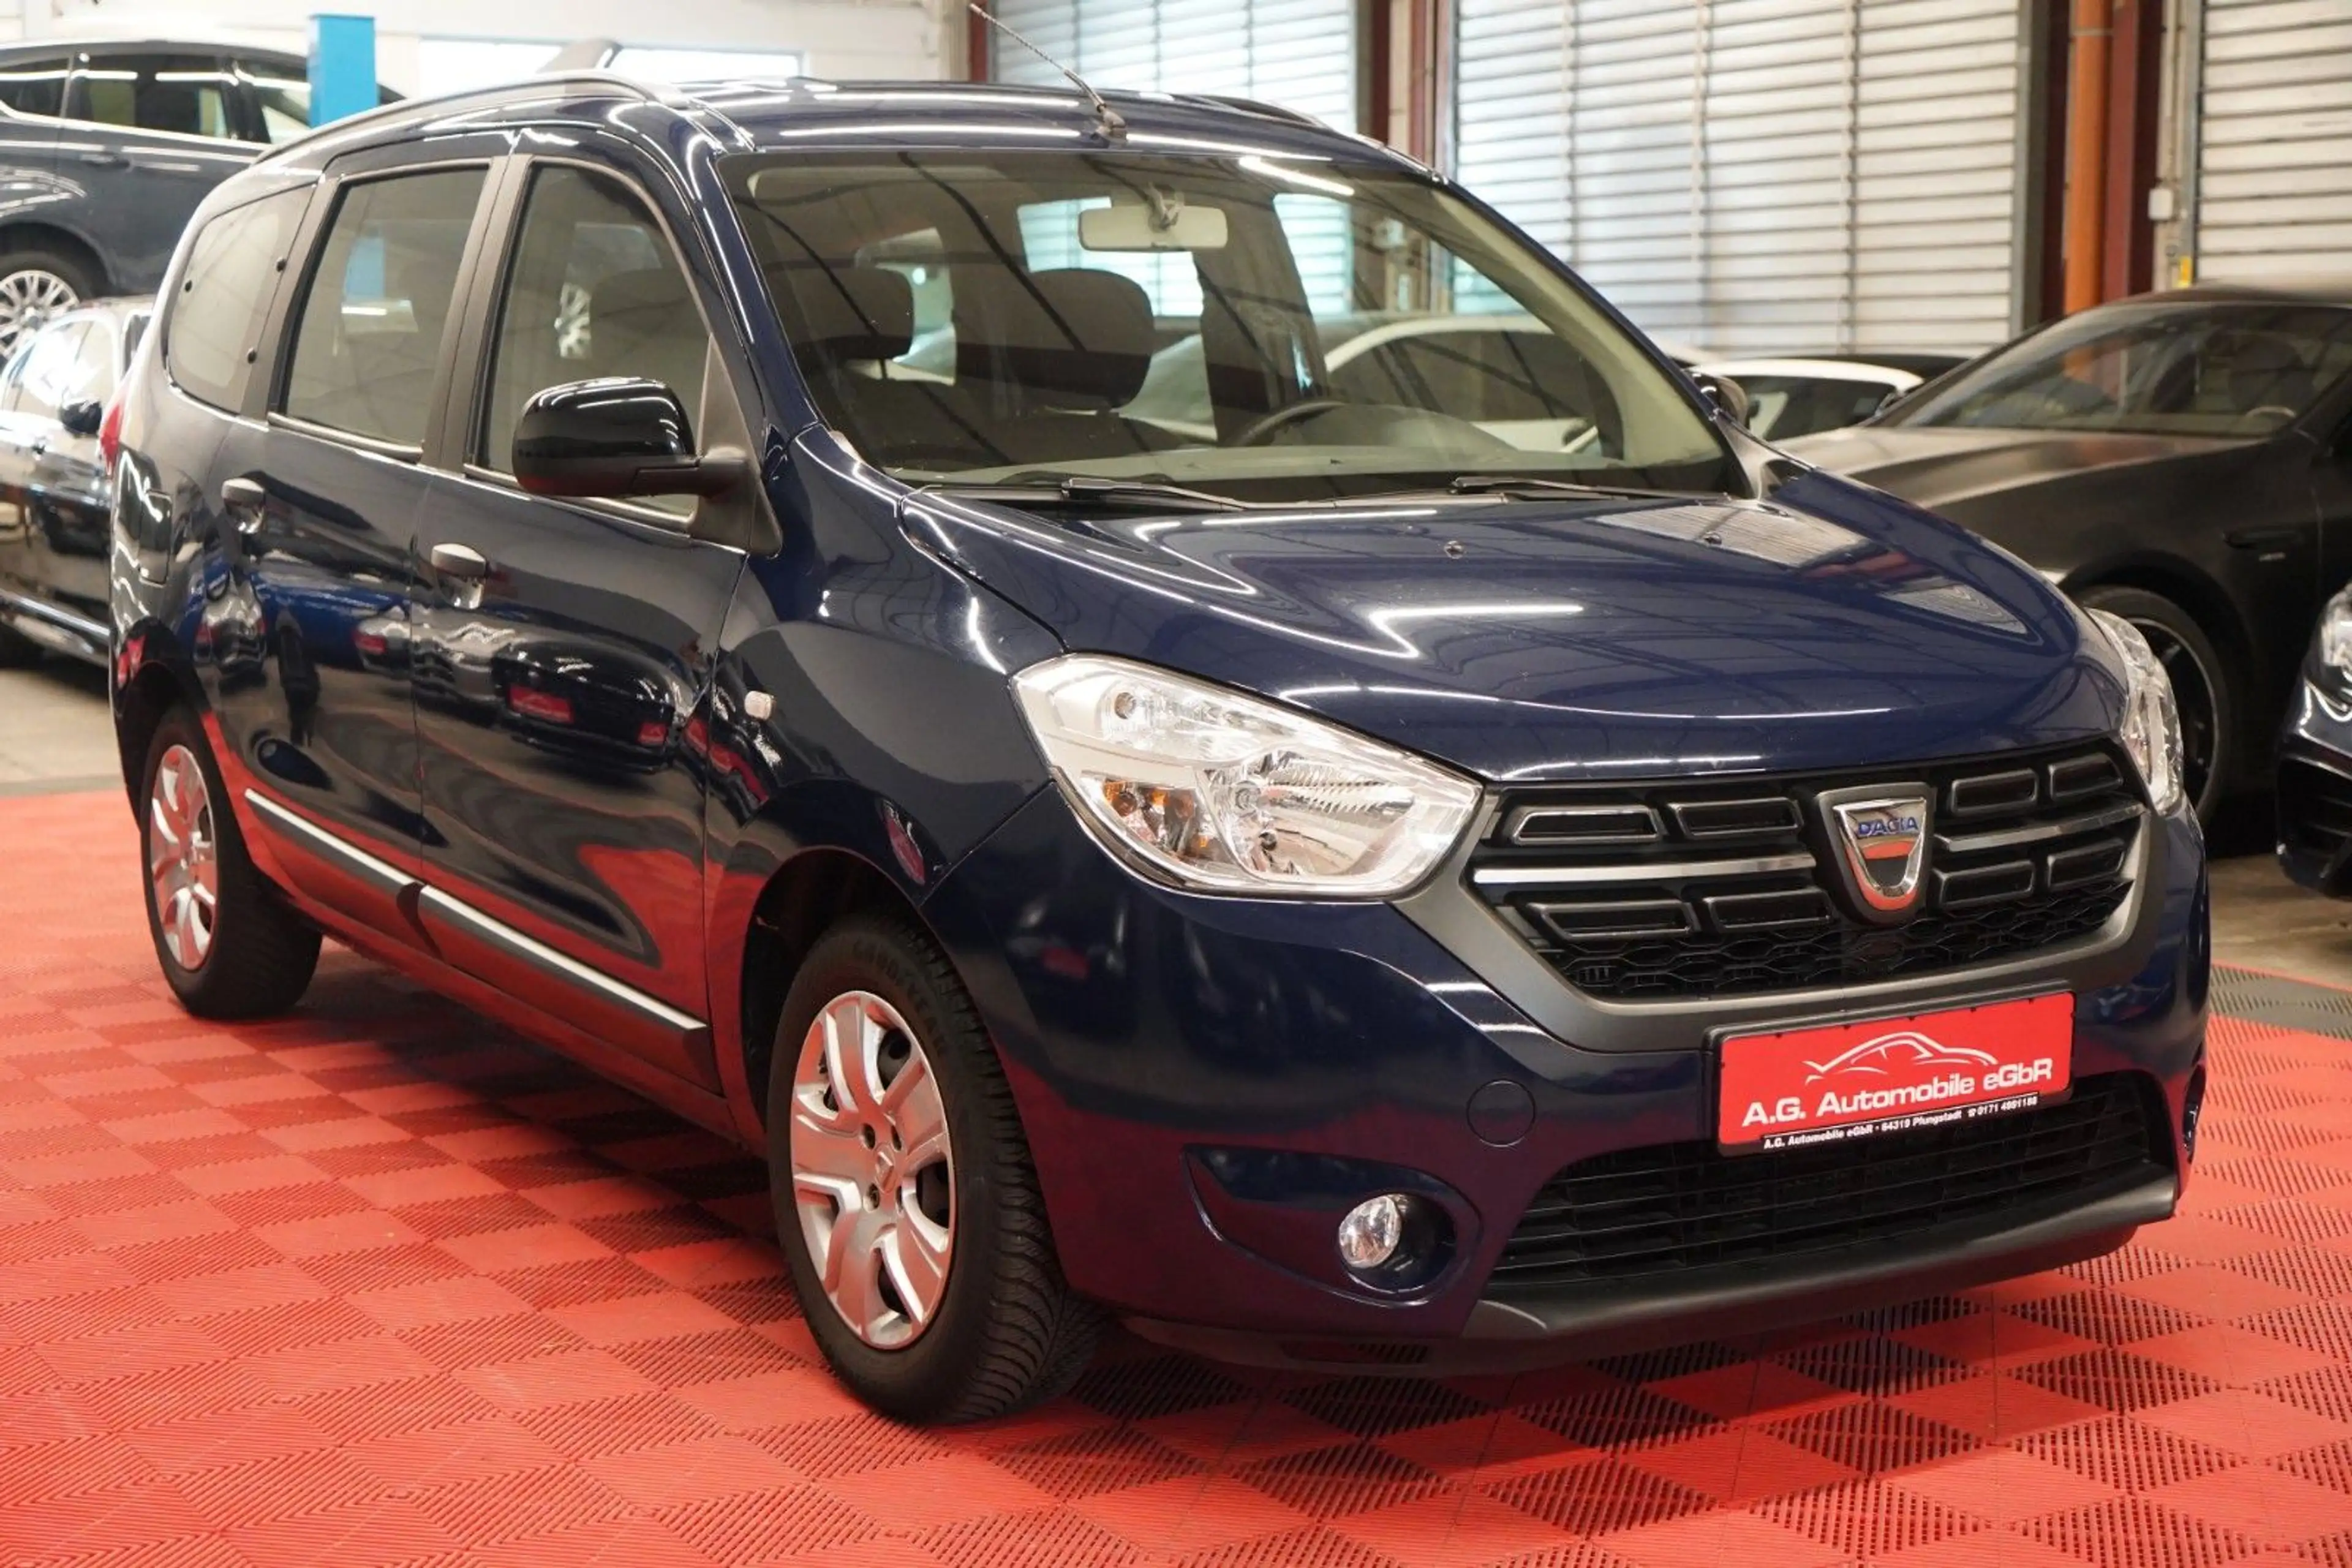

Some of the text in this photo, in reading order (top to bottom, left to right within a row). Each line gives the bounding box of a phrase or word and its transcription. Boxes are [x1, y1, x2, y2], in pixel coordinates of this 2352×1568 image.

[1858, 816, 1918, 837] DACIA
[1741, 1058, 2053, 1127] A.G. Automobile eGbR
[1763, 1137, 1785, 1149] A.G.
[1788, 1129, 1845, 1145] Automobile
[1846, 1123, 1874, 1137] eGbR
